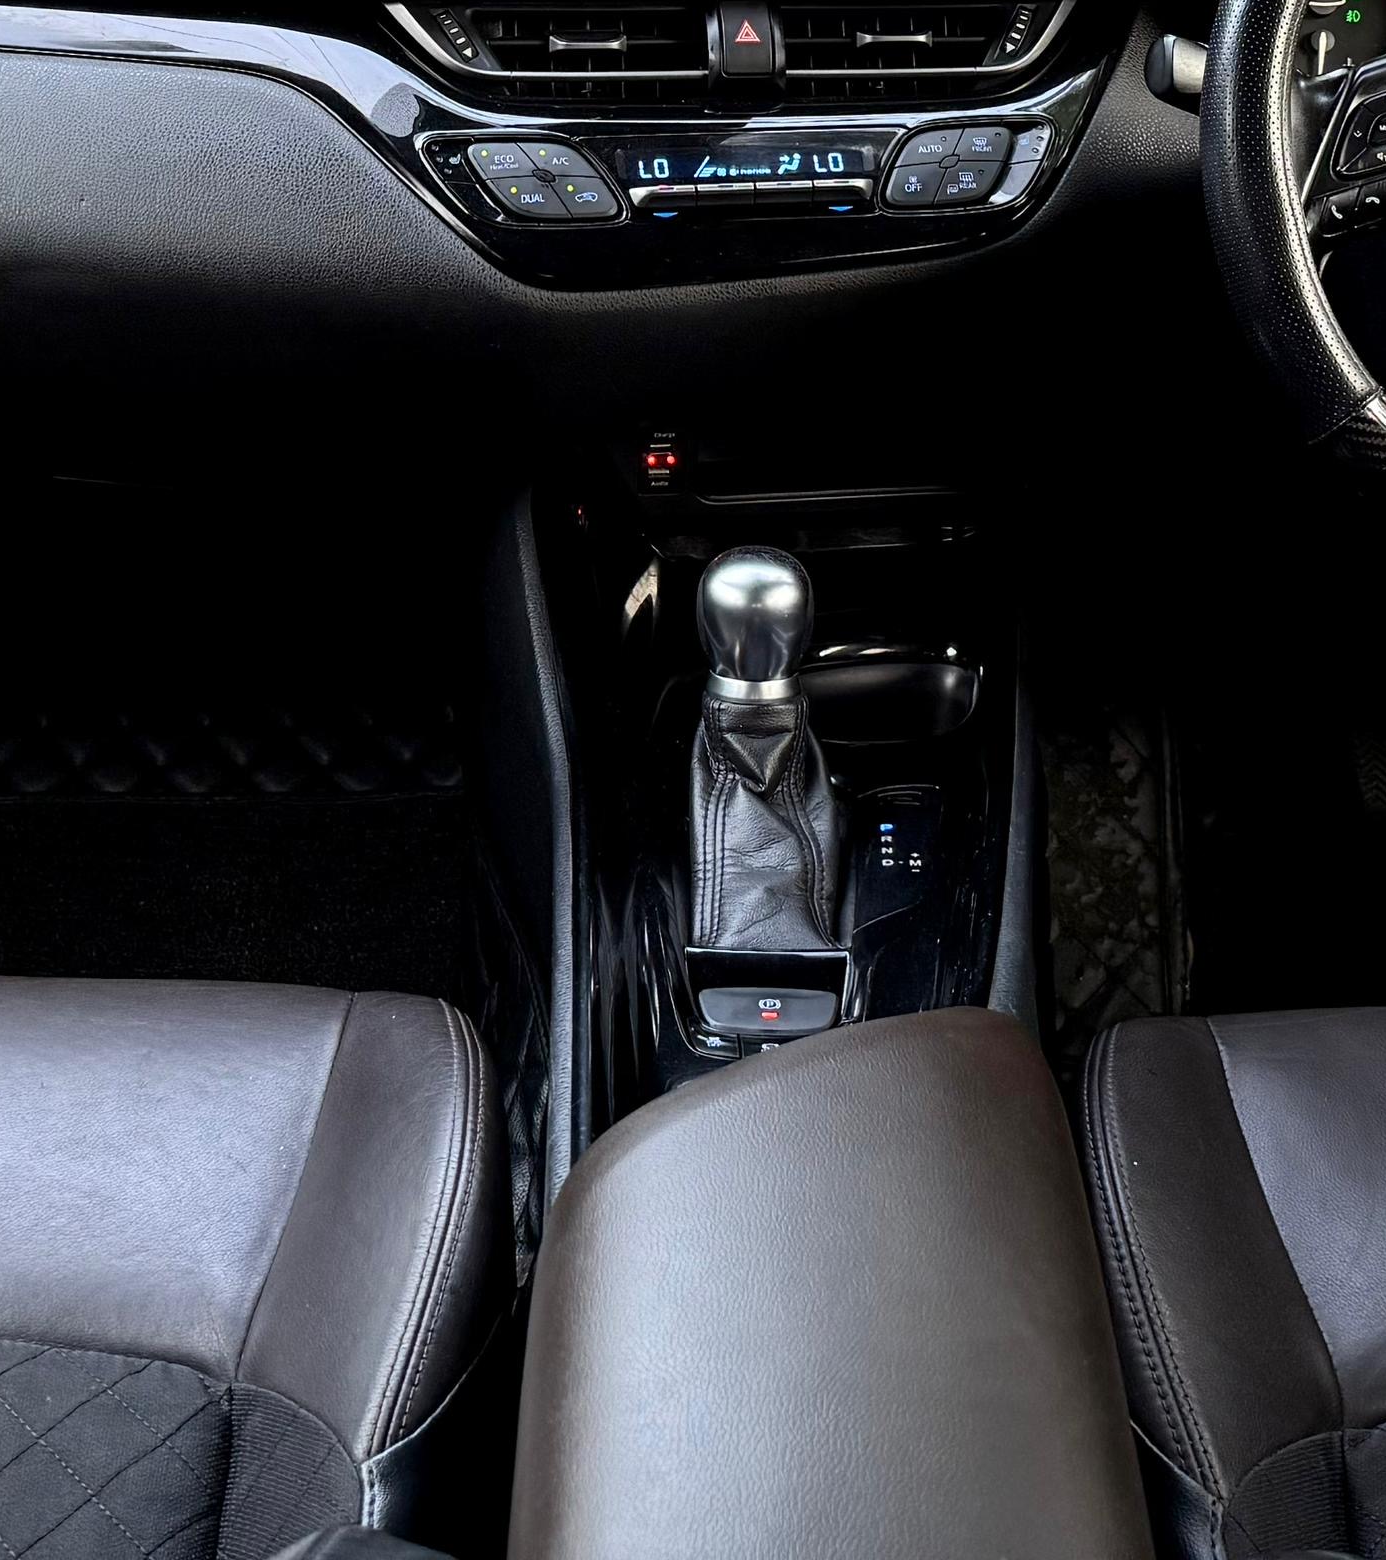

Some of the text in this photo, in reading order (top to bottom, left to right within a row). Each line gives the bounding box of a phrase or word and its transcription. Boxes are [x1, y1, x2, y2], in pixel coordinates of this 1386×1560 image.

[918, 144, 943, 154] AUTO
[494, 154, 514, 164] ECO
[552, 156, 570, 166] A/C
[813, 152, 844, 173] LO
[638, 158, 669, 179] LO
[904, 183, 923, 193] OFF
[520, 193, 545, 204] DUAL
[880, 823, 894, 832] P
